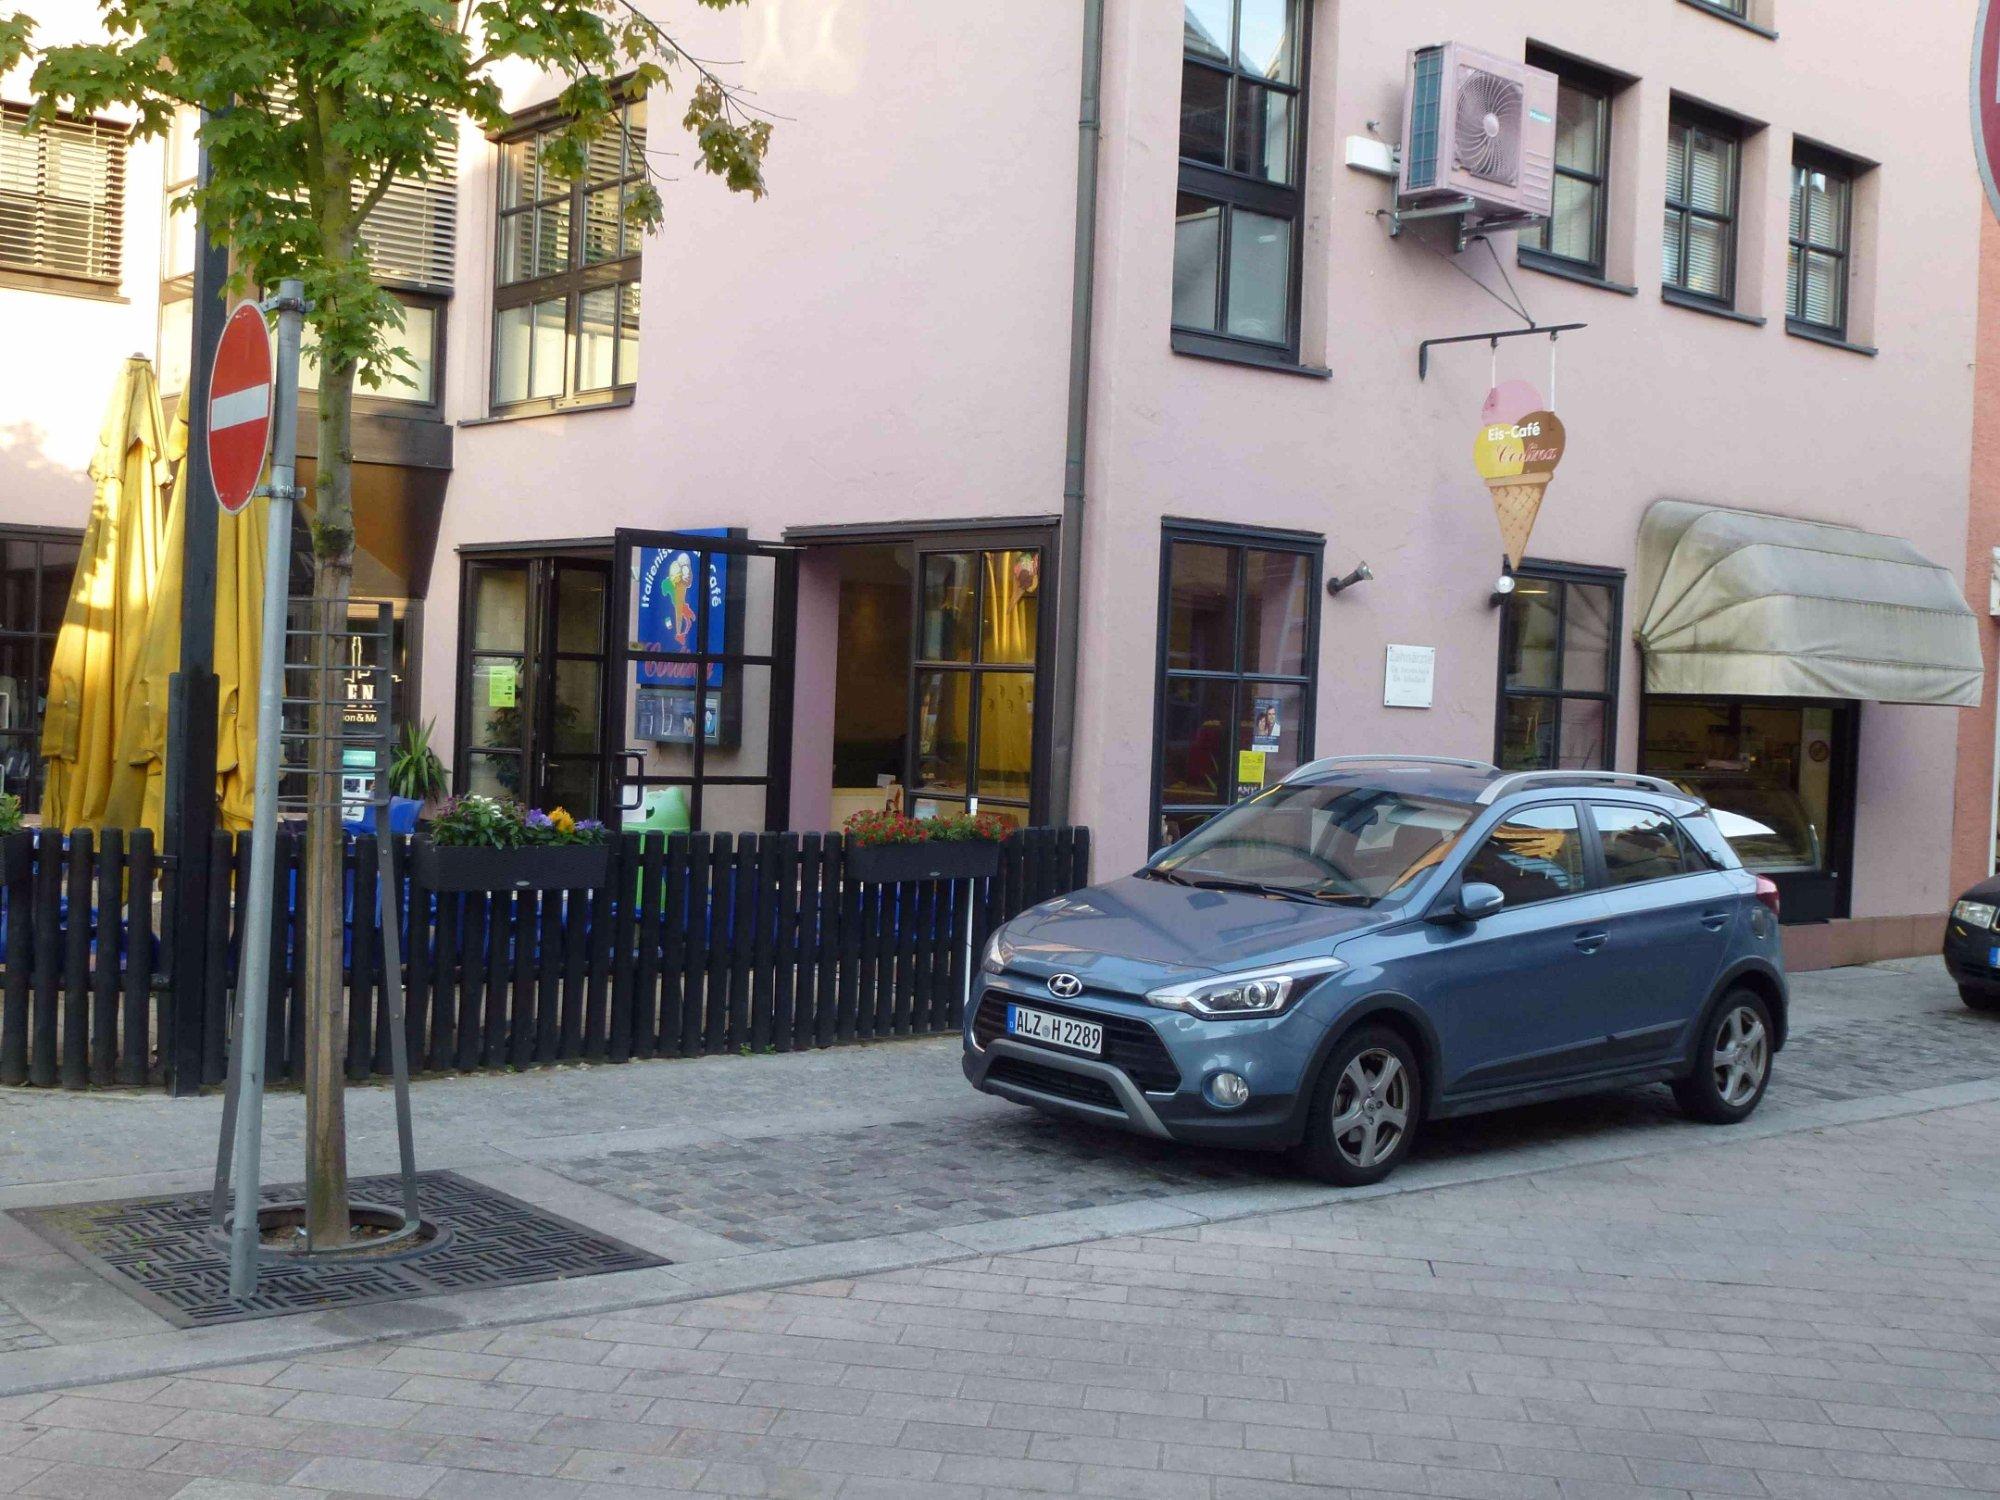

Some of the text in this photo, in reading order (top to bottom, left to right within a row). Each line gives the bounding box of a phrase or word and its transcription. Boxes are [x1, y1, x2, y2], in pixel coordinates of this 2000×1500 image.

[1487, 421, 1541, 441] Eis-Café
[1016, 1010, 1041, 1036] ALZ
[1051, 1018, 1061, 1041] H
[1064, 1021, 1101, 1050] 2289
